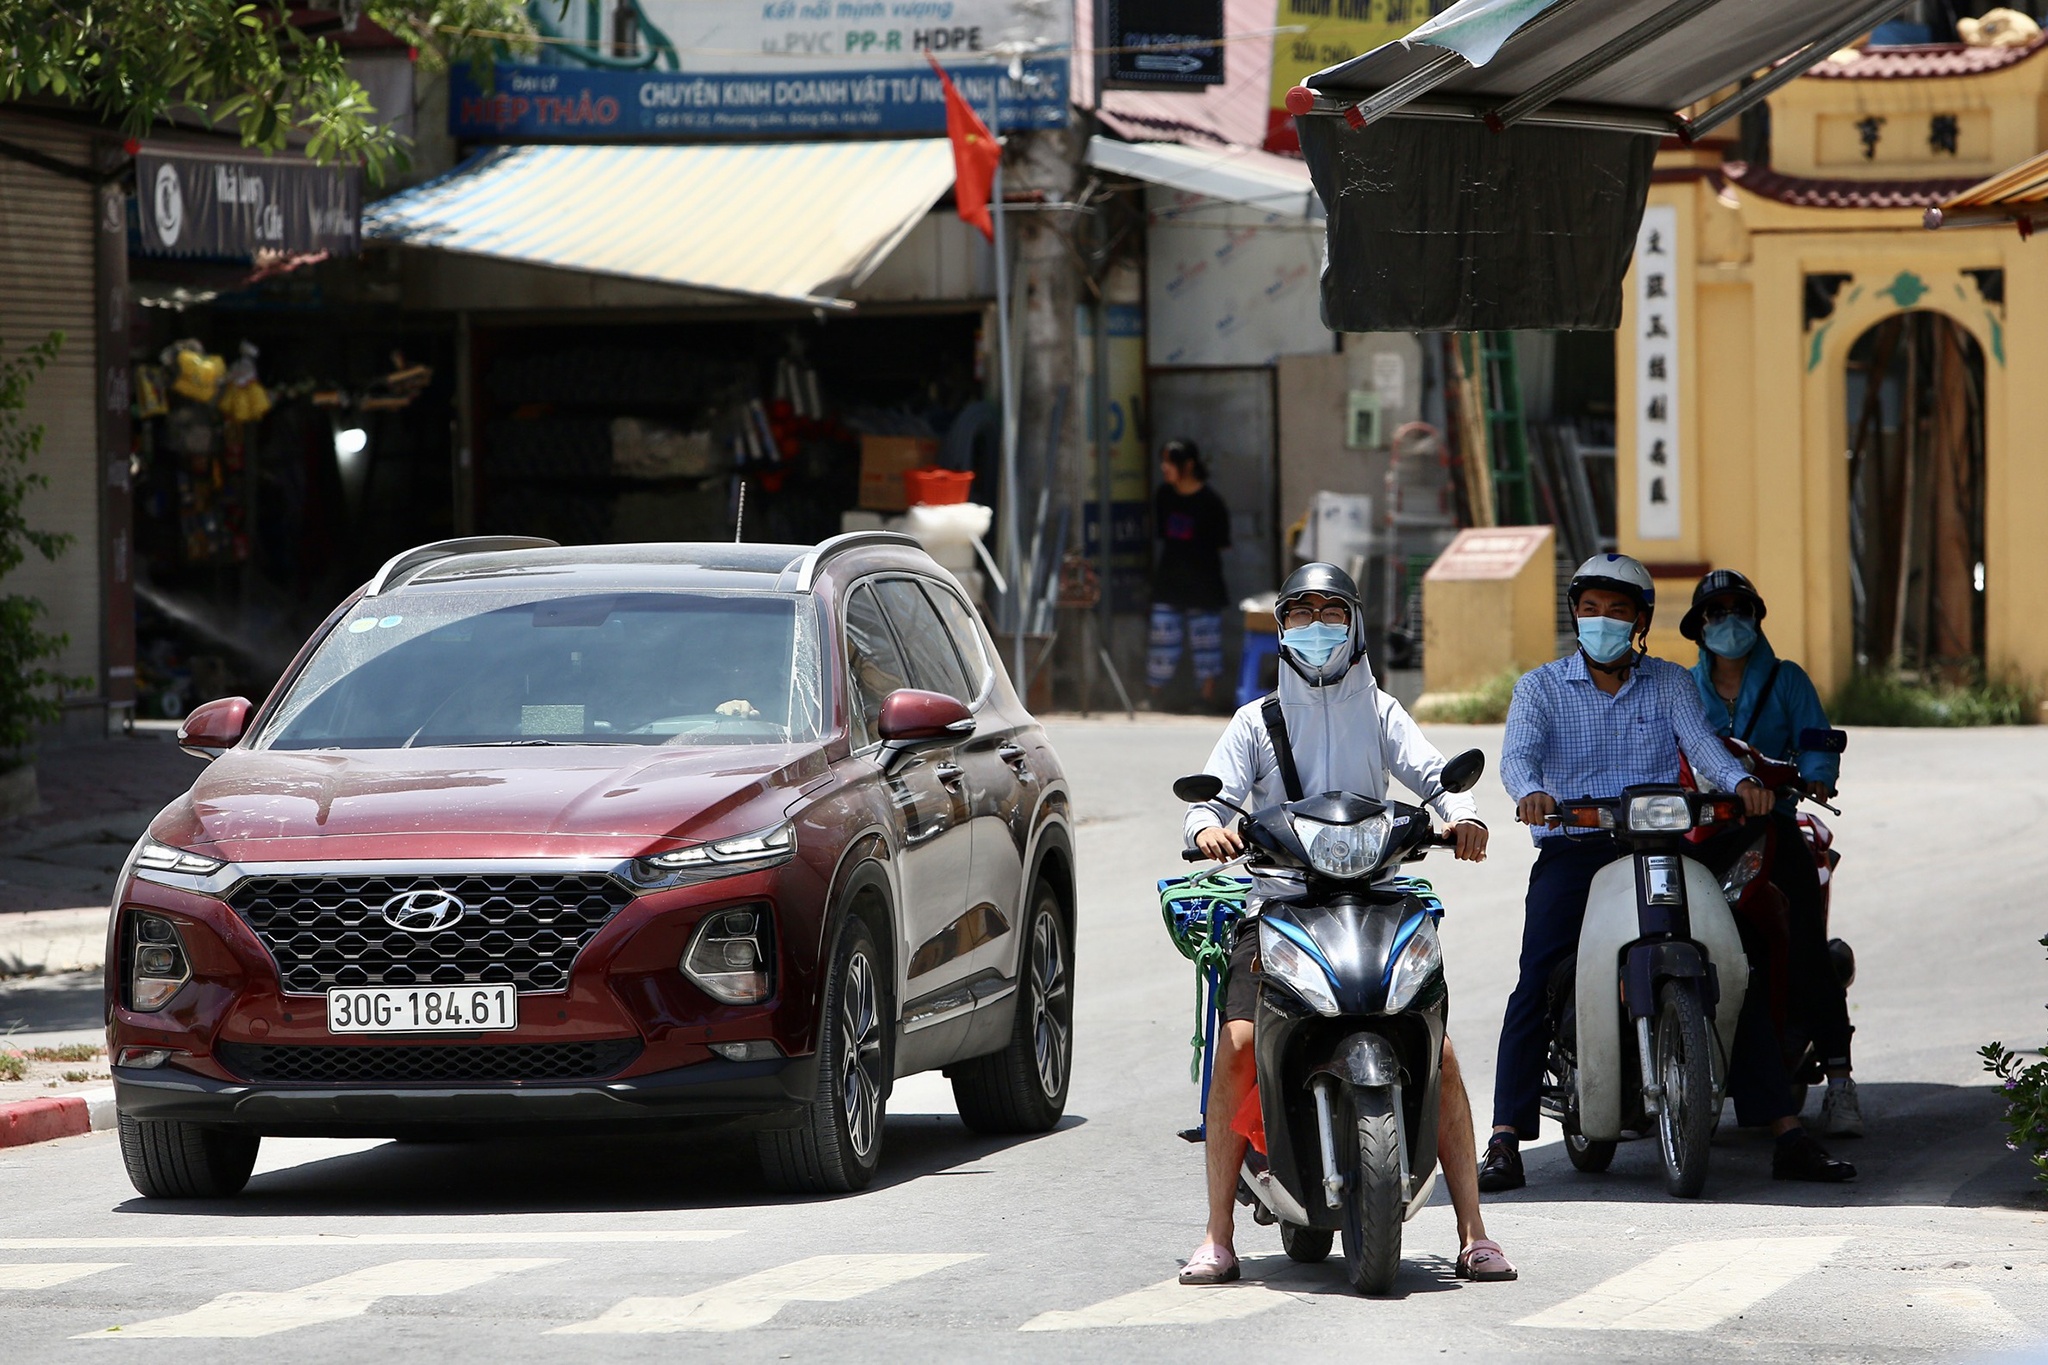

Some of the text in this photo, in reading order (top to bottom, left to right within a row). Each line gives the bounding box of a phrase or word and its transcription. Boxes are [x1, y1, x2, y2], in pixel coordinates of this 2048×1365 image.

[845, 30, 902, 52] PP-R
[913, 26, 982, 51] HDPE
[461, 89, 620, 130] HIỆP THẢO
[639, 78, 719, 107] CHUYÊN
[722, 80, 772, 106] KINH
[774, 79, 848, 106] DOANH
[850, 75, 887, 111] VẬT
[891, 76, 919, 103] TƯ
[334, 990, 506, 1027] 30G-184.61
[1263, 1000, 1289, 1020] HONDA
